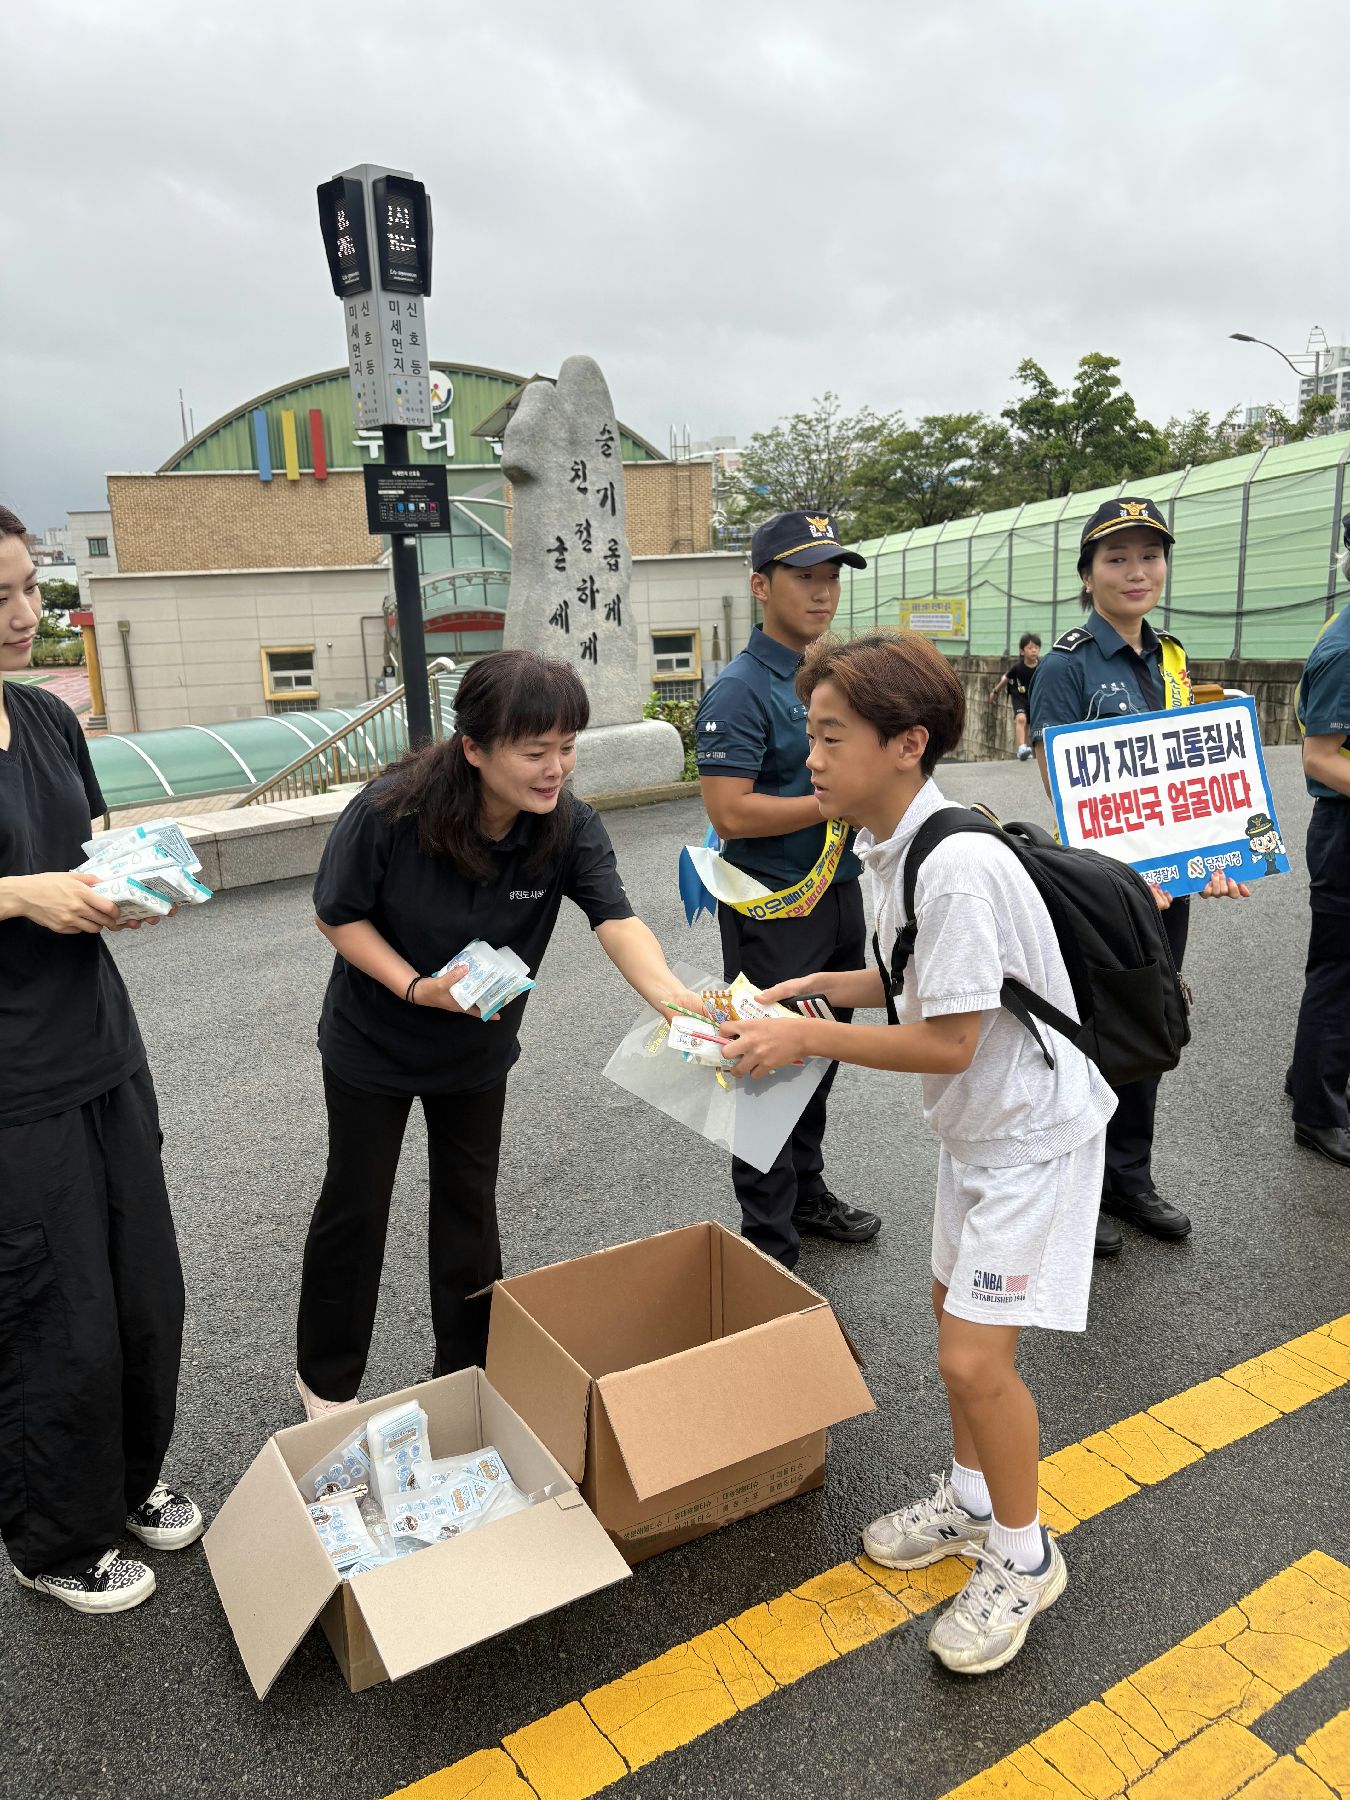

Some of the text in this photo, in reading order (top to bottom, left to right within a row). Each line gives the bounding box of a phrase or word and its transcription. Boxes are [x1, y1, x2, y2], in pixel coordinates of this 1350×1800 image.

[389, 300, 404, 373] 미세먼지
[406, 302, 422, 375] 신호등
[595, 424, 621, 627] 슬기롭게
[569, 460, 600, 665] 친절하게
[1065, 720, 1247, 788] 내가 지킨 교통질서
[1077, 770, 1252, 839] 대한민국 얼굴이다
[1206, 852, 1243, 870] 당진시청
[971, 1291, 1013, 1303] ESTABLISHED
[982, 1272, 1003, 1291] NBA
[938, 1526, 959, 1540] N
[1010, 1599, 1029, 1615] N
